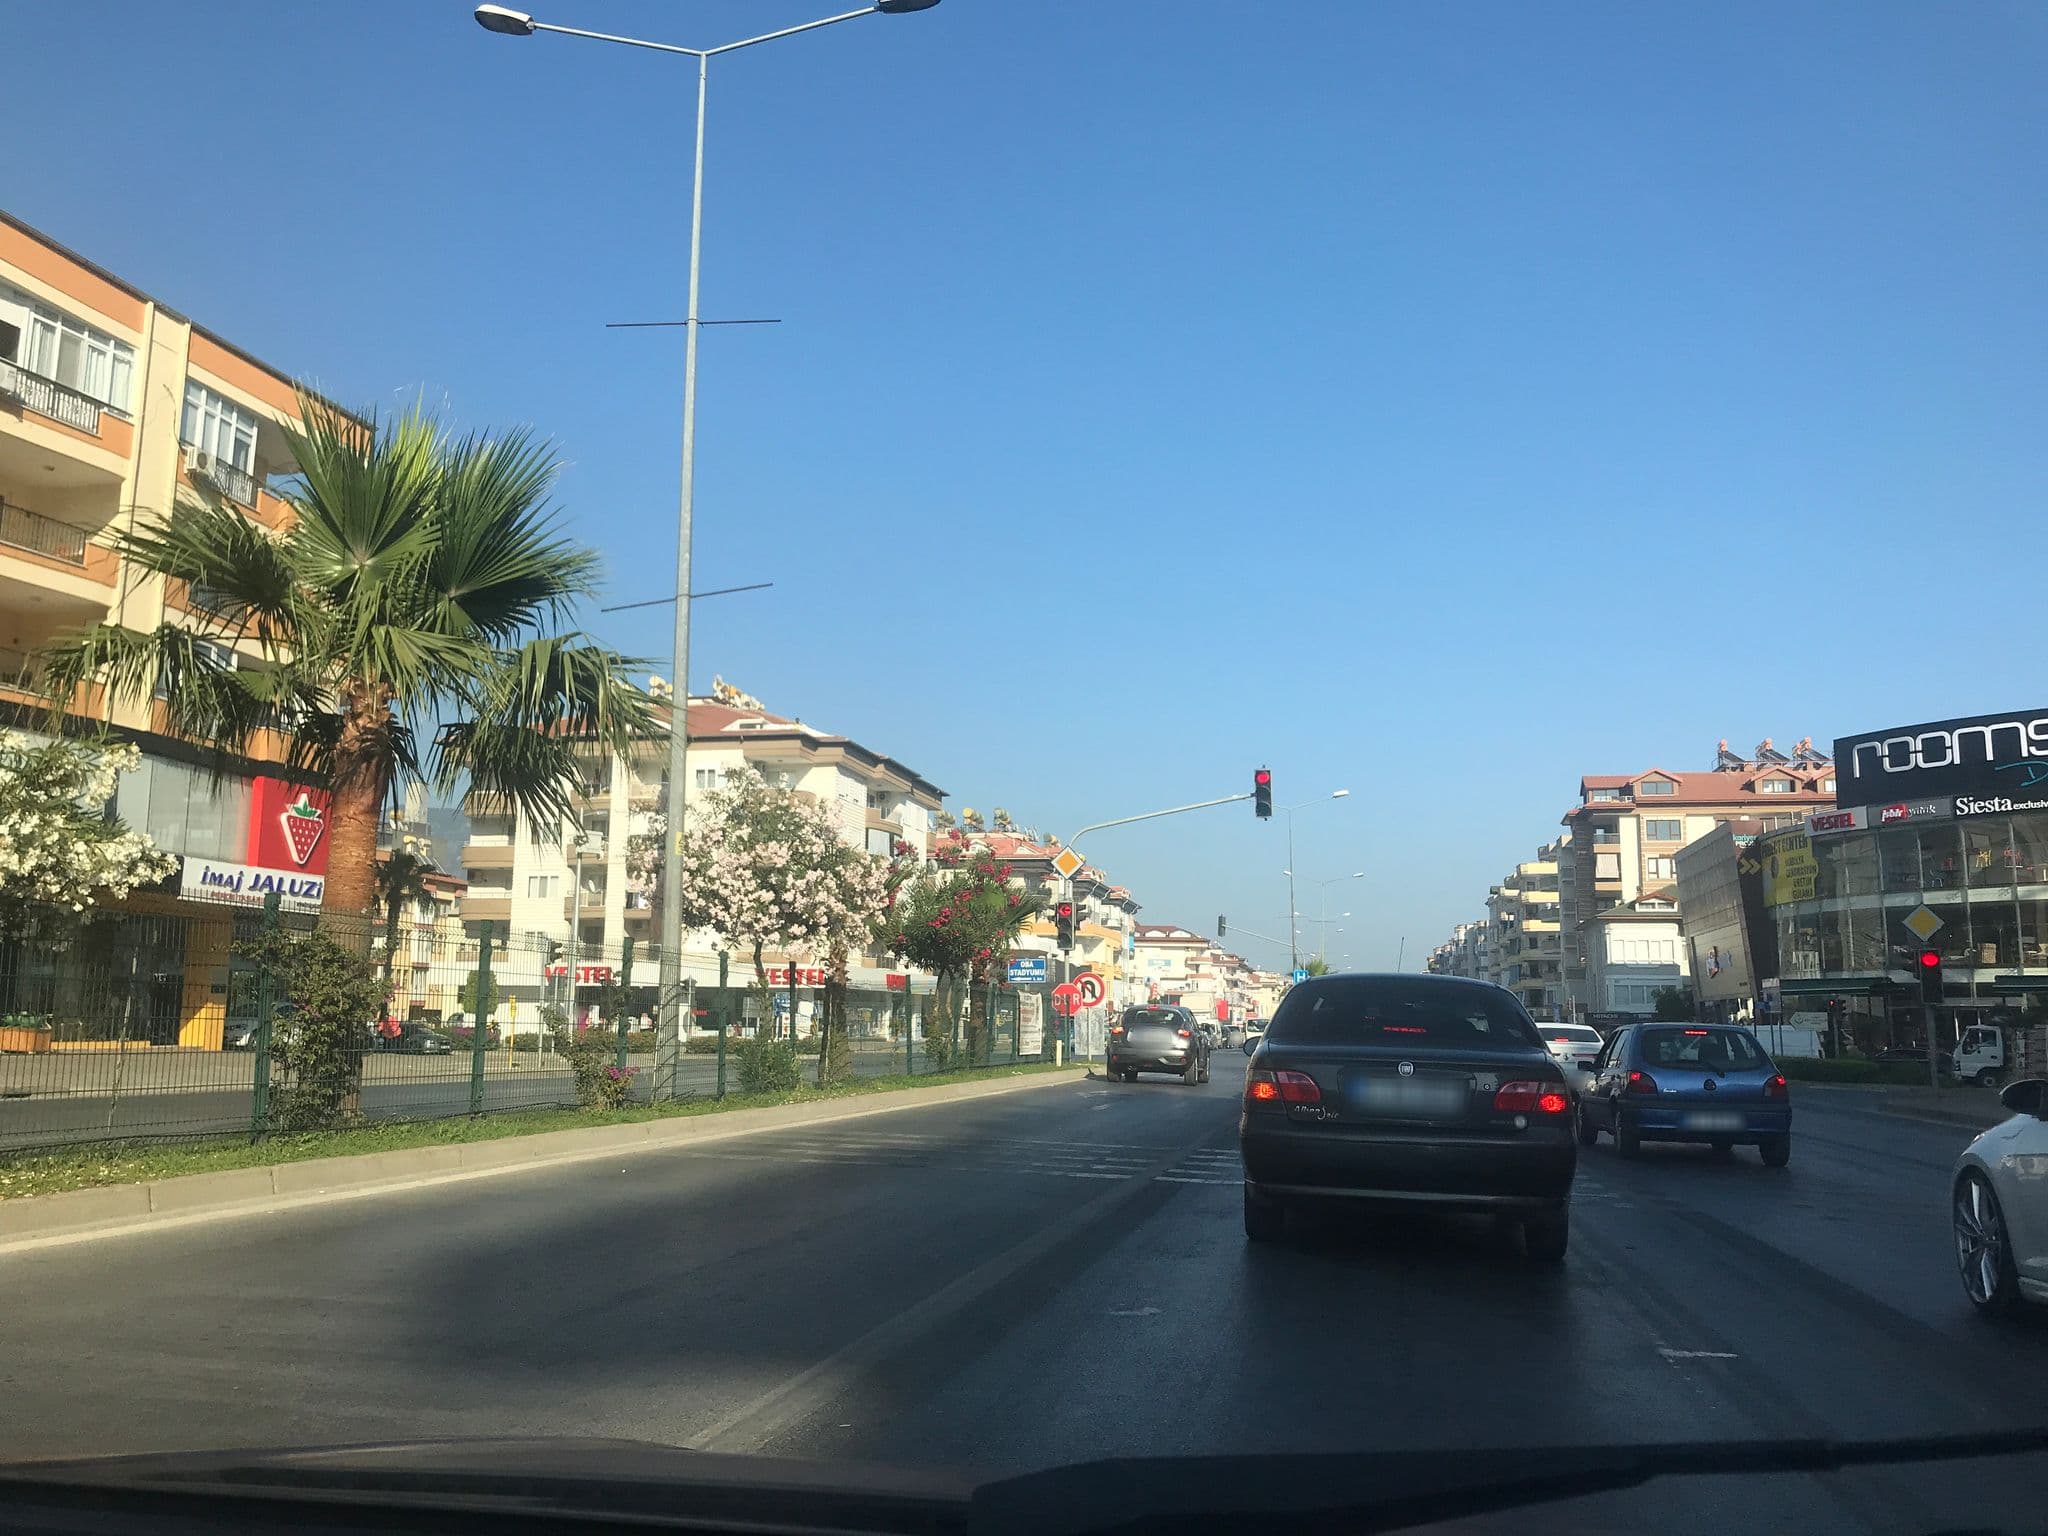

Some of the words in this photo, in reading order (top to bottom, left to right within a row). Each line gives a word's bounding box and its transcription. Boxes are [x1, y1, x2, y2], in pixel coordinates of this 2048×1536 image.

[1852, 719, 2048, 778] rooms
[1956, 796, 2013, 816] Siesta
[1811, 812, 1856, 832] VESTEL
